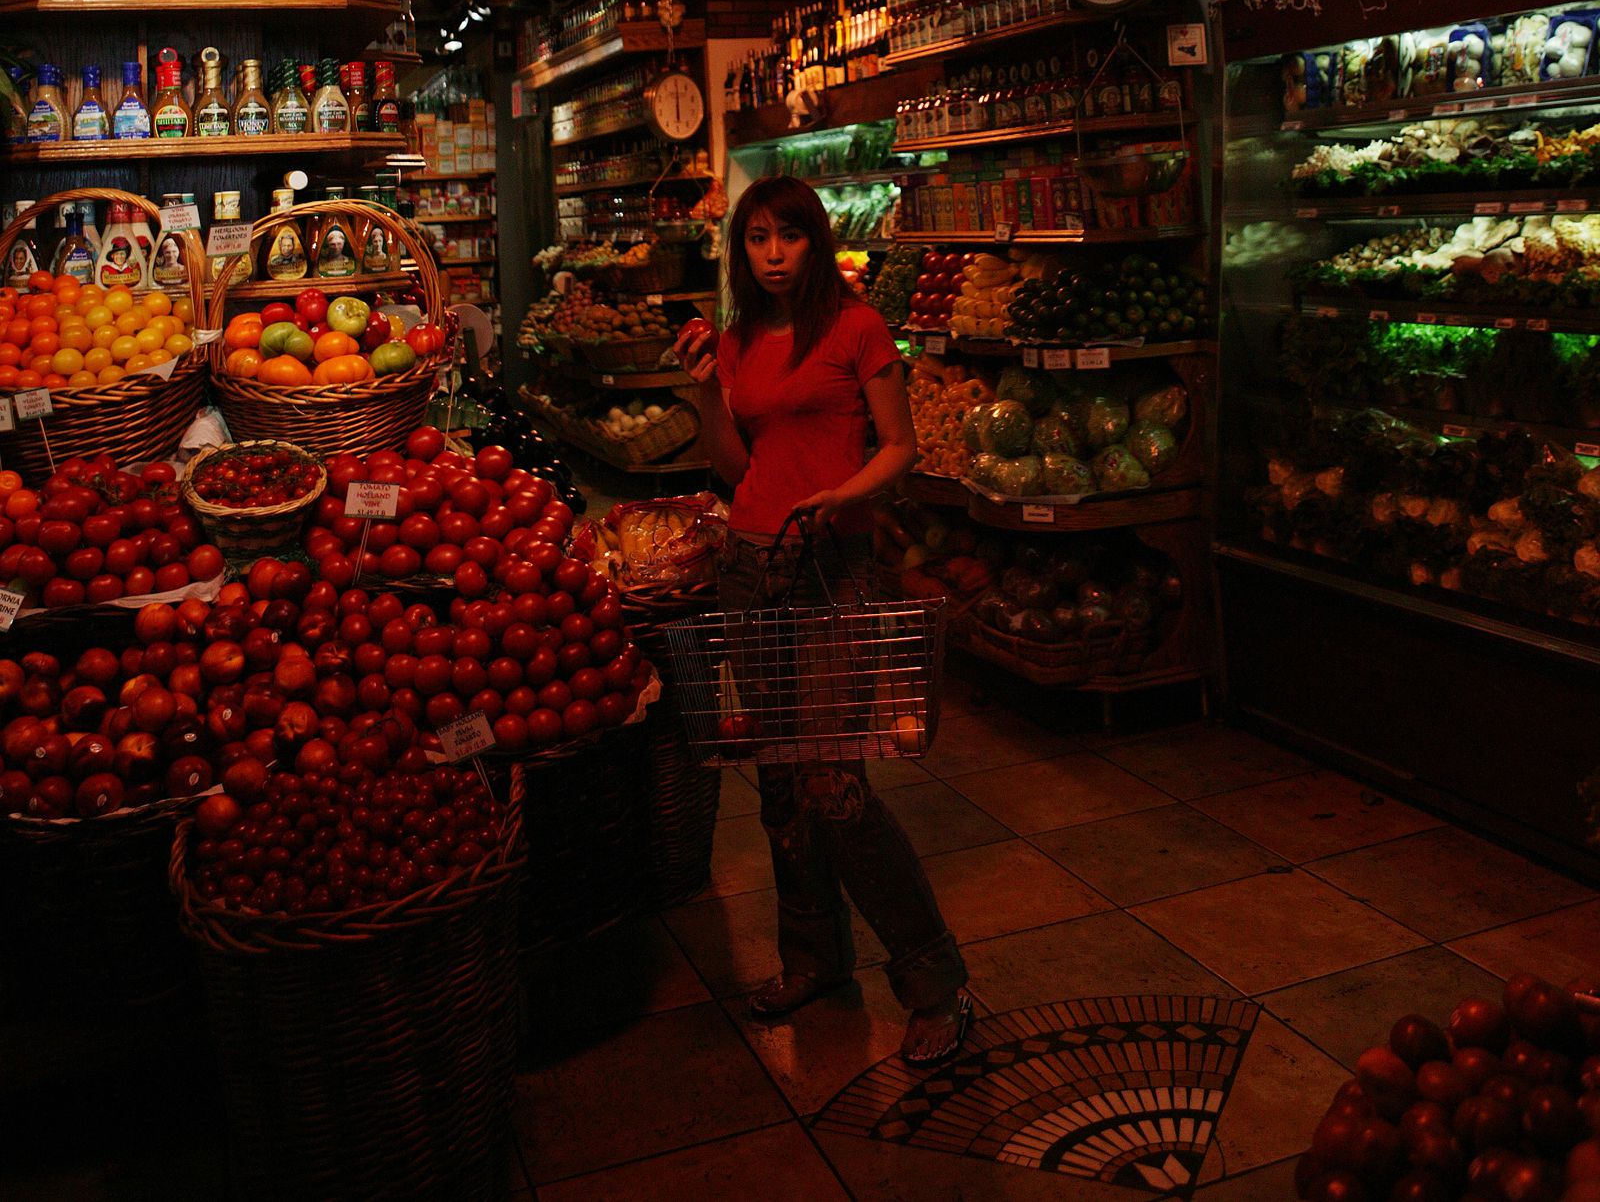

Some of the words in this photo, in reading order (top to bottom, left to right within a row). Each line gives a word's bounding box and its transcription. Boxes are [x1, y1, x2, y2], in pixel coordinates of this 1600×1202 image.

[214, 226, 248, 234] HEIRLOOM
[213, 233, 248, 241] TOMATOES
[359, 483, 391, 491] TOMATO
[356, 491, 391, 499] HOLLAND
[454, 730, 481, 746] TOMATO
